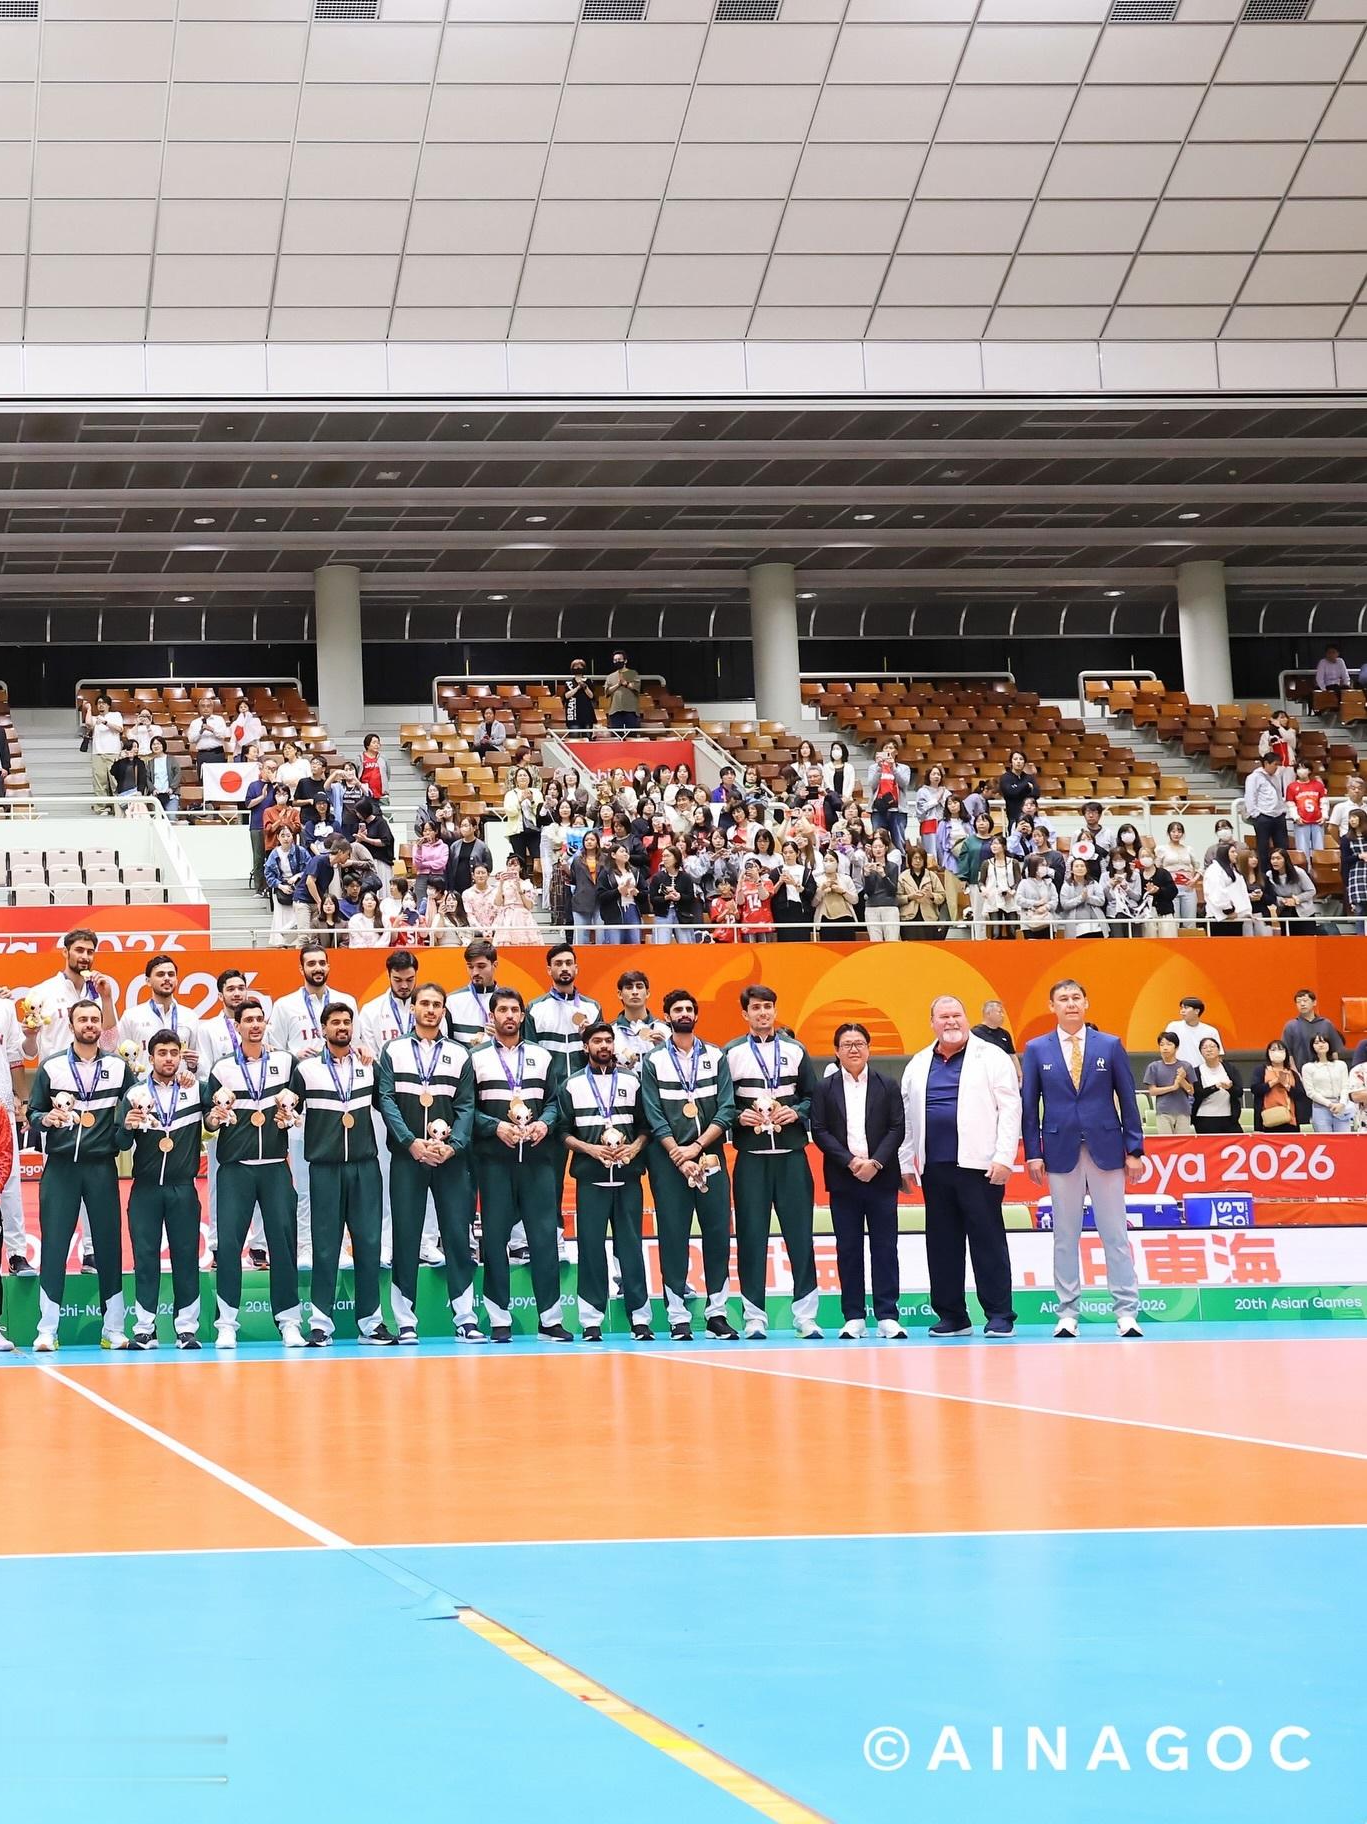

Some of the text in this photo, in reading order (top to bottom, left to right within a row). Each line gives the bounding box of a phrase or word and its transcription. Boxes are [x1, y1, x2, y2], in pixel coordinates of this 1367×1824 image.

[302, 1029, 321, 1041] IR
[382, 1030, 399, 1041] IR
[1221, 1144, 1335, 1181] 2026
[1136, 1299, 1167, 1312] 2026
[1235, 1296, 1363, 1310] 20th Asian Games
